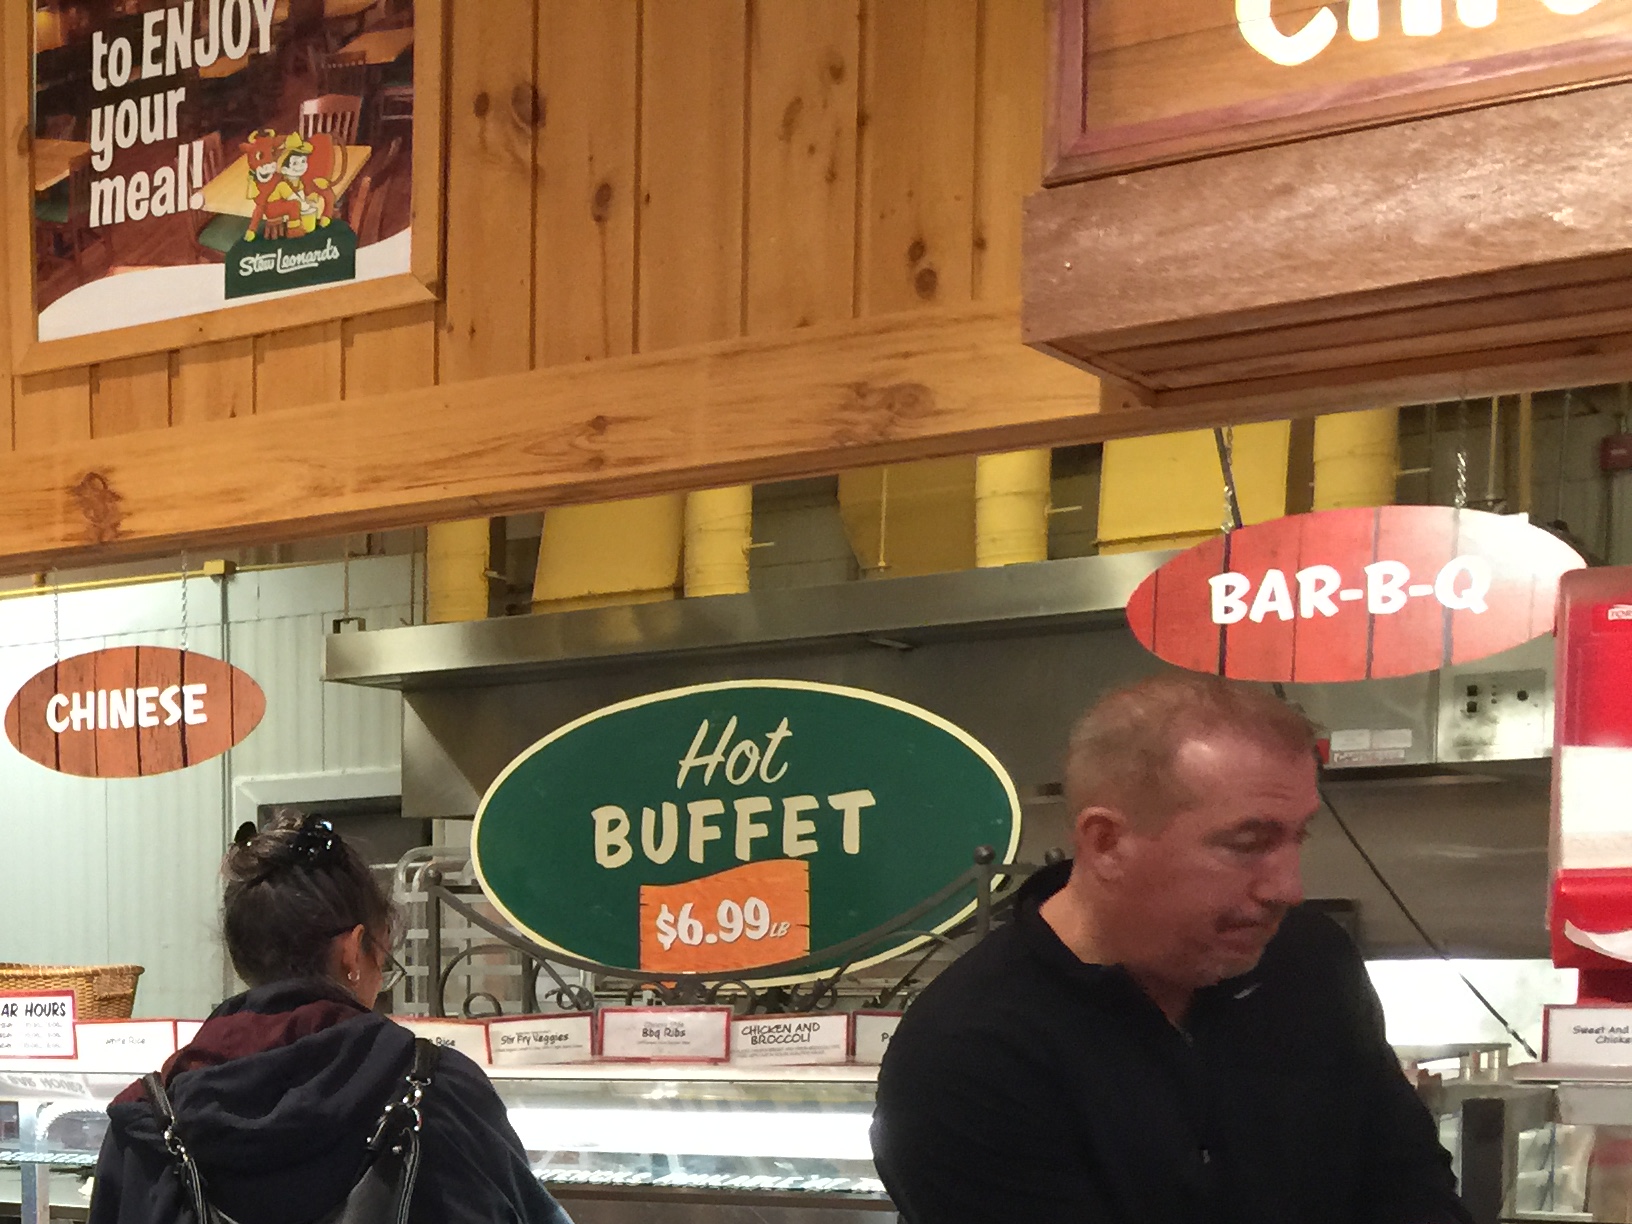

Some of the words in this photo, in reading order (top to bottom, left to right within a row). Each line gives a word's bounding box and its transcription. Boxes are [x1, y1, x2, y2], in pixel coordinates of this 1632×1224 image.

[92, 31, 132, 91] to
[141, 0, 276, 79] ENJOY
[90, 87, 186, 172] your
[89, 141, 204, 228] meal!
[239, 253, 276, 276] Stew
[276, 238, 340, 274] Leonard's
[1208, 554, 1493, 625] BAR-B-Q
[46, 683, 208, 733] CHINESE
[677, 715, 793, 789] Hot
[591, 789, 876, 869] BUFFET
[656, 896, 770, 951] $6.99
[769, 921, 791, 938] LB
[25, 1002, 66, 1017] HOURS
[741, 1023, 792, 1035] CHICKEN
[795, 1022, 821, 1033] AND
[1573, 1025, 1605, 1034] Sweet
[1608, 1025, 1630, 1034] And
[517, 1034, 531, 1046] Fry
[533, 1033, 569, 1045] Veggies
[642, 1028, 660, 1039] Bbq
[664, 1028, 686, 1038] Ribs
[751, 1033, 811, 1045] BROCCOLI
[1595, 1035, 1632, 1044] Chicke
